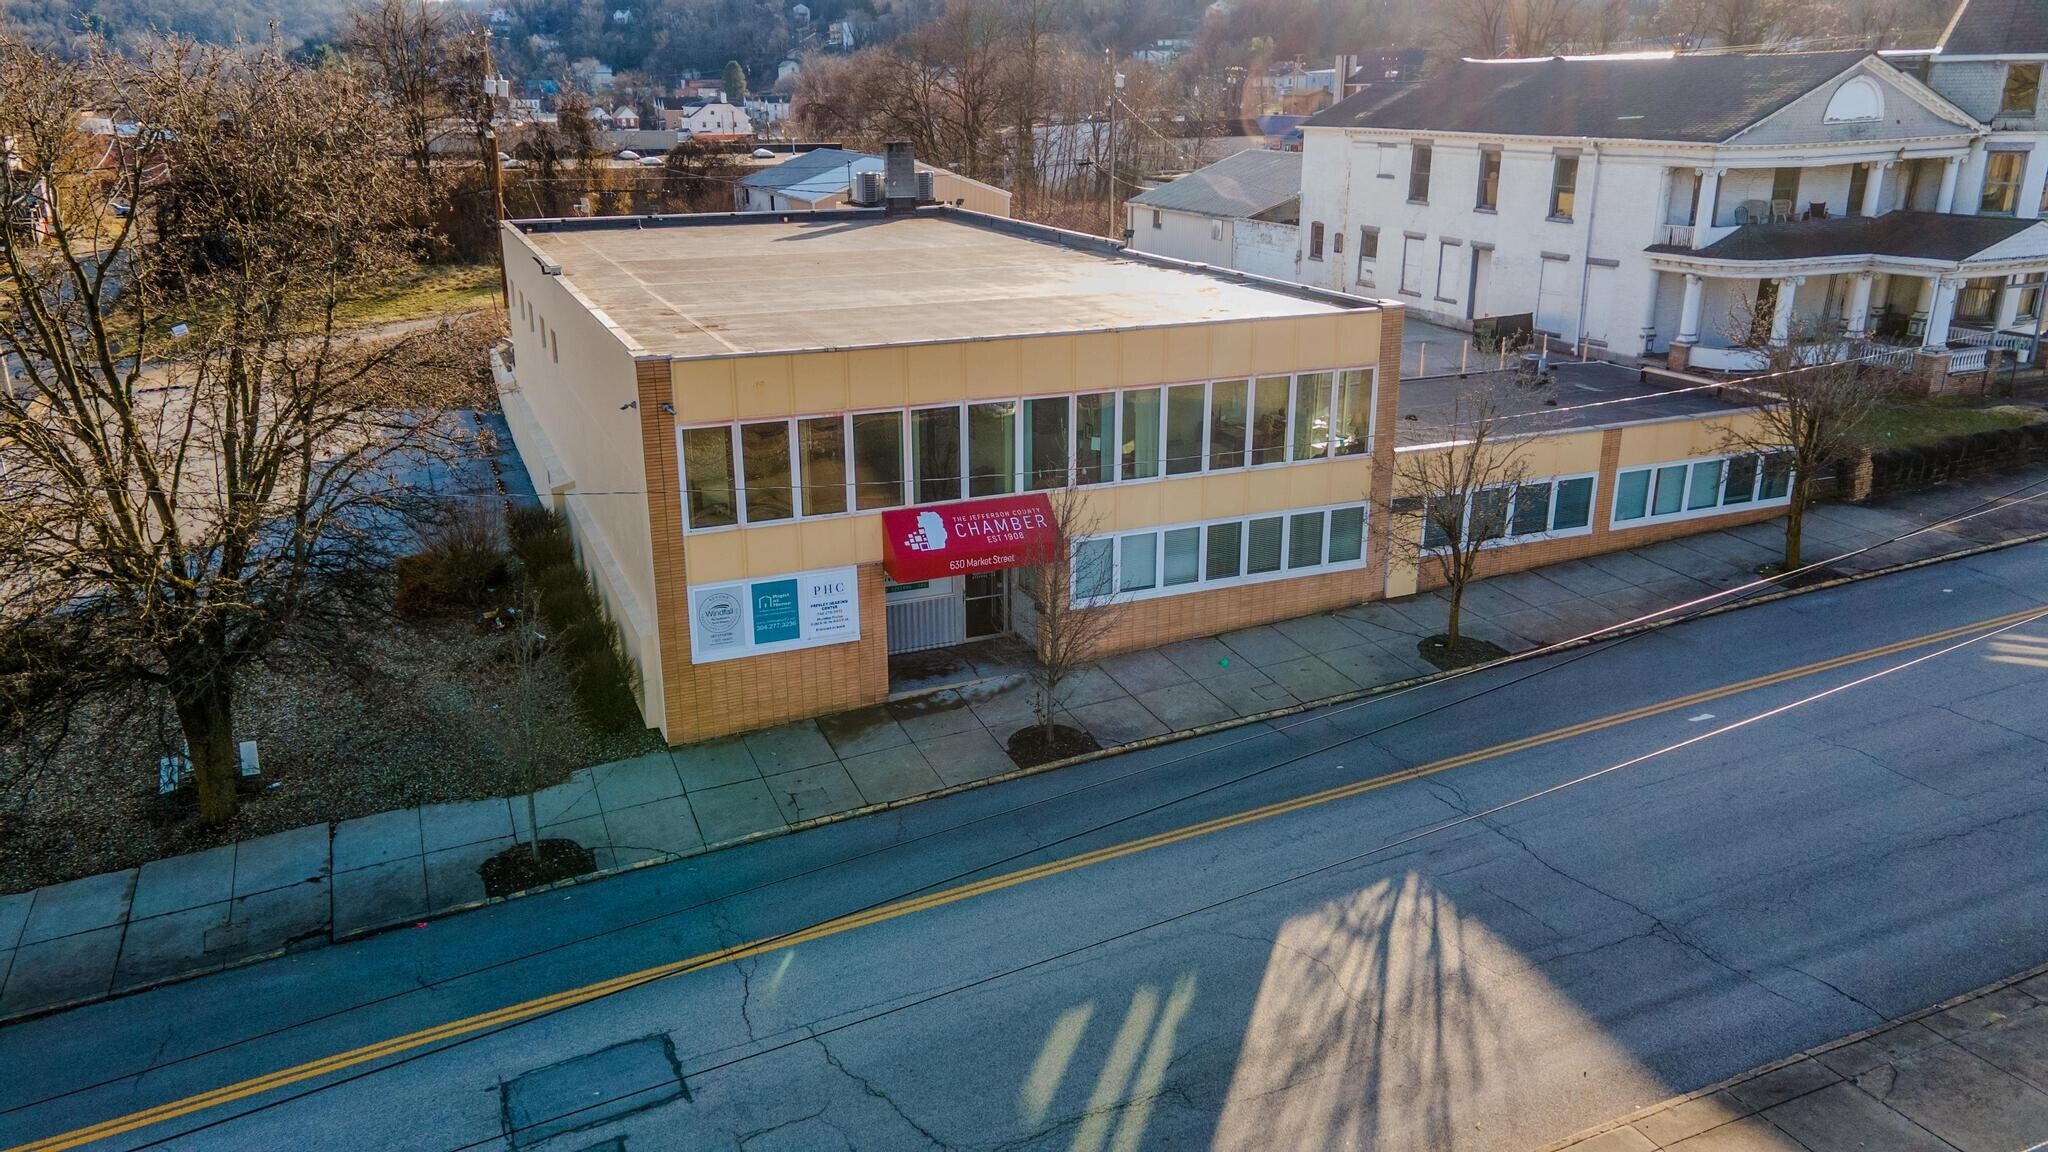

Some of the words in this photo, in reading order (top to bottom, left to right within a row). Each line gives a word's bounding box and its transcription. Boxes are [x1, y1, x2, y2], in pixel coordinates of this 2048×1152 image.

[952, 515, 966, 523] THE
[969, 511, 1010, 521] JEFFERSON
[1012, 507, 1041, 516] COUNTY
[954, 514, 1048, 538] CHAMBER
[986, 534, 1003, 544] EST
[1004, 532, 1025, 541] 1908
[949, 559, 966, 570] 630
[966, 556, 992, 568] Market
[992, 554, 1016, 564] Street
